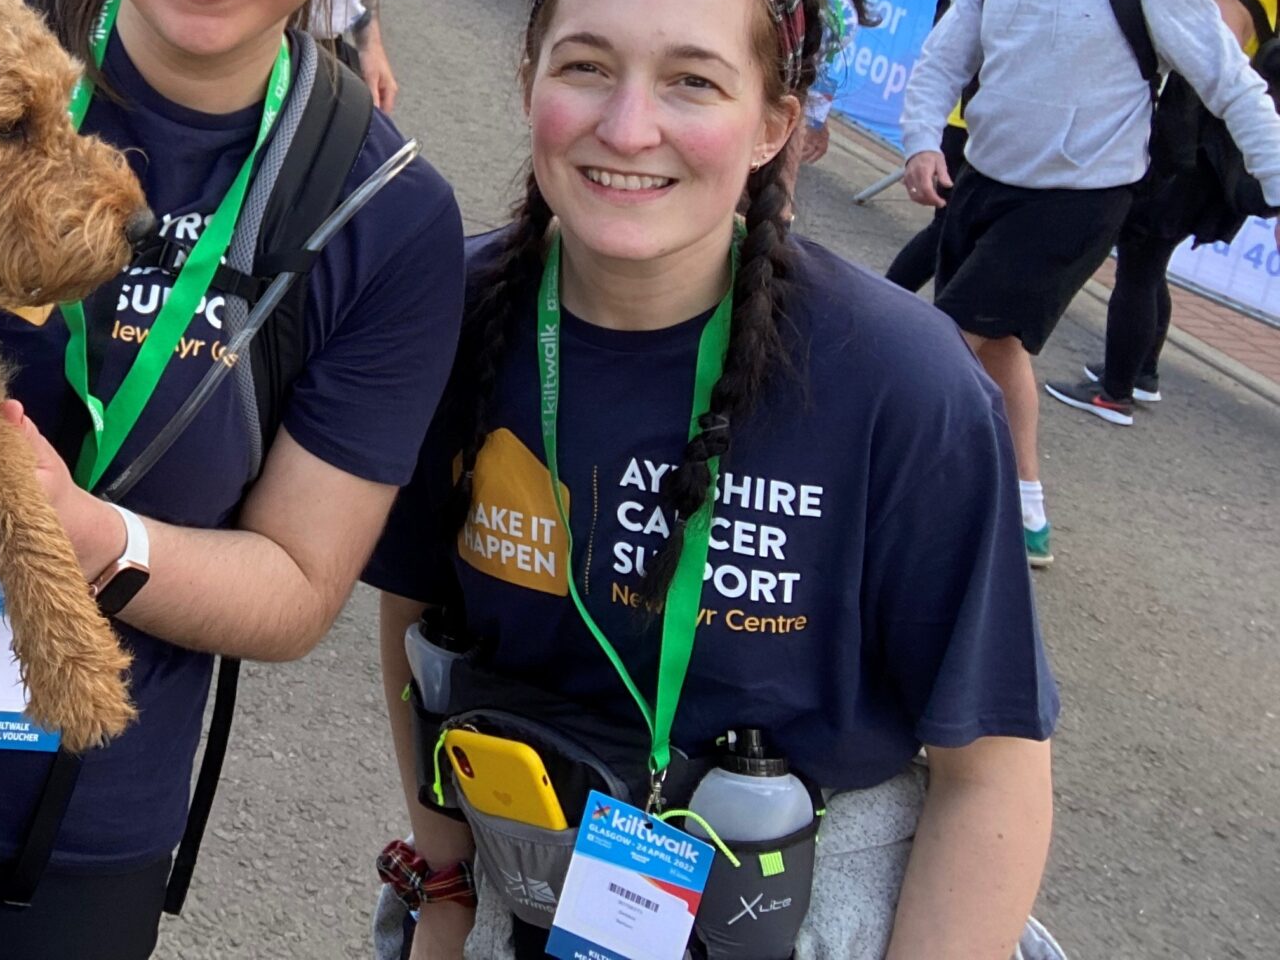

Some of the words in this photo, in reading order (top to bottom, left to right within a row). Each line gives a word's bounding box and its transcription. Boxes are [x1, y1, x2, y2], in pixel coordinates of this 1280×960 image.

[540, 323, 558, 415] kiltwalk
[619, 457, 824, 518] AYHIRE
[463, 522, 556, 578] HAPPEN
[531, 516, 557, 545] IT
[616, 500, 787, 561] CACER
[725, 609, 808, 635] Centre
[3, 732, 39, 742] VOUCHER
[588, 823, 632, 846] GLASGOW
[635, 843, 647, 853] 24
[647, 847, 673, 864] APRIL
[673, 859, 695, 874] 2022
[611, 808, 700, 864] kiltwalk
